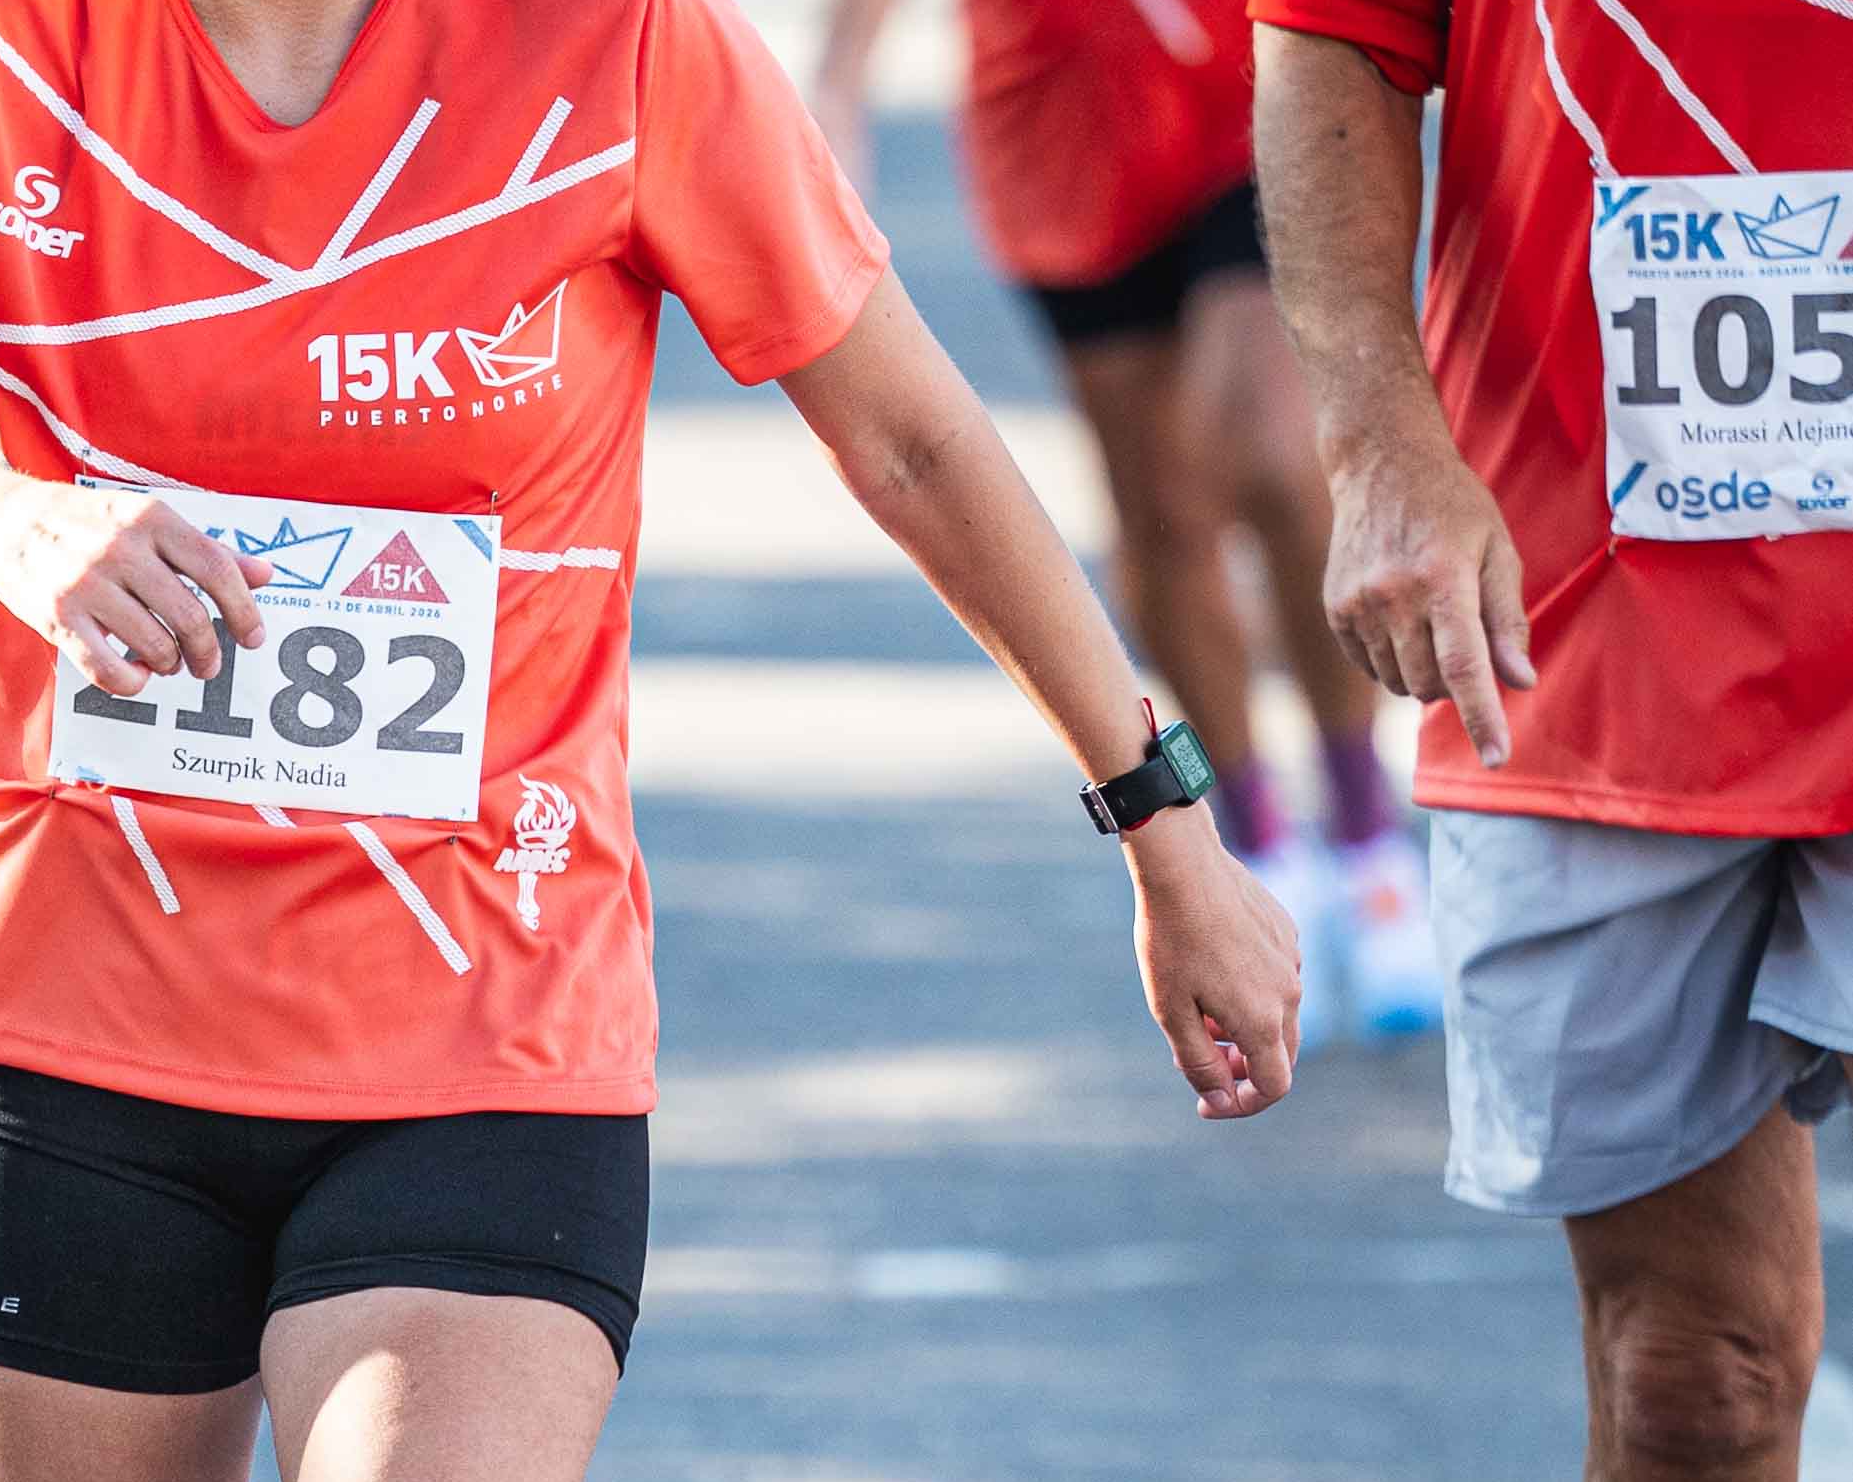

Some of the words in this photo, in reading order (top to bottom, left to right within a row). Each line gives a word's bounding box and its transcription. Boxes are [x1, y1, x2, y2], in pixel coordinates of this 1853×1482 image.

[1625, 211, 1726, 261] 15K
[308, 331, 455, 402] 15K
[319, 405, 456, 427] PUERTO
[471, 373, 563, 419] NORTE
[1681, 421, 1767, 444] Morassi
[1655, 469, 1772, 516] osde
[367, 563, 427, 594] 15K
[254, 594, 310, 609] ROSARIO
[328, 601, 340, 611] 12
[347, 602, 362, 613] DE
[367, 604, 405, 617] ABRIL
[410, 607, 441, 619] 2026
[171, 748, 266, 782] Szurpik
[276, 759, 348, 789] Nadia
